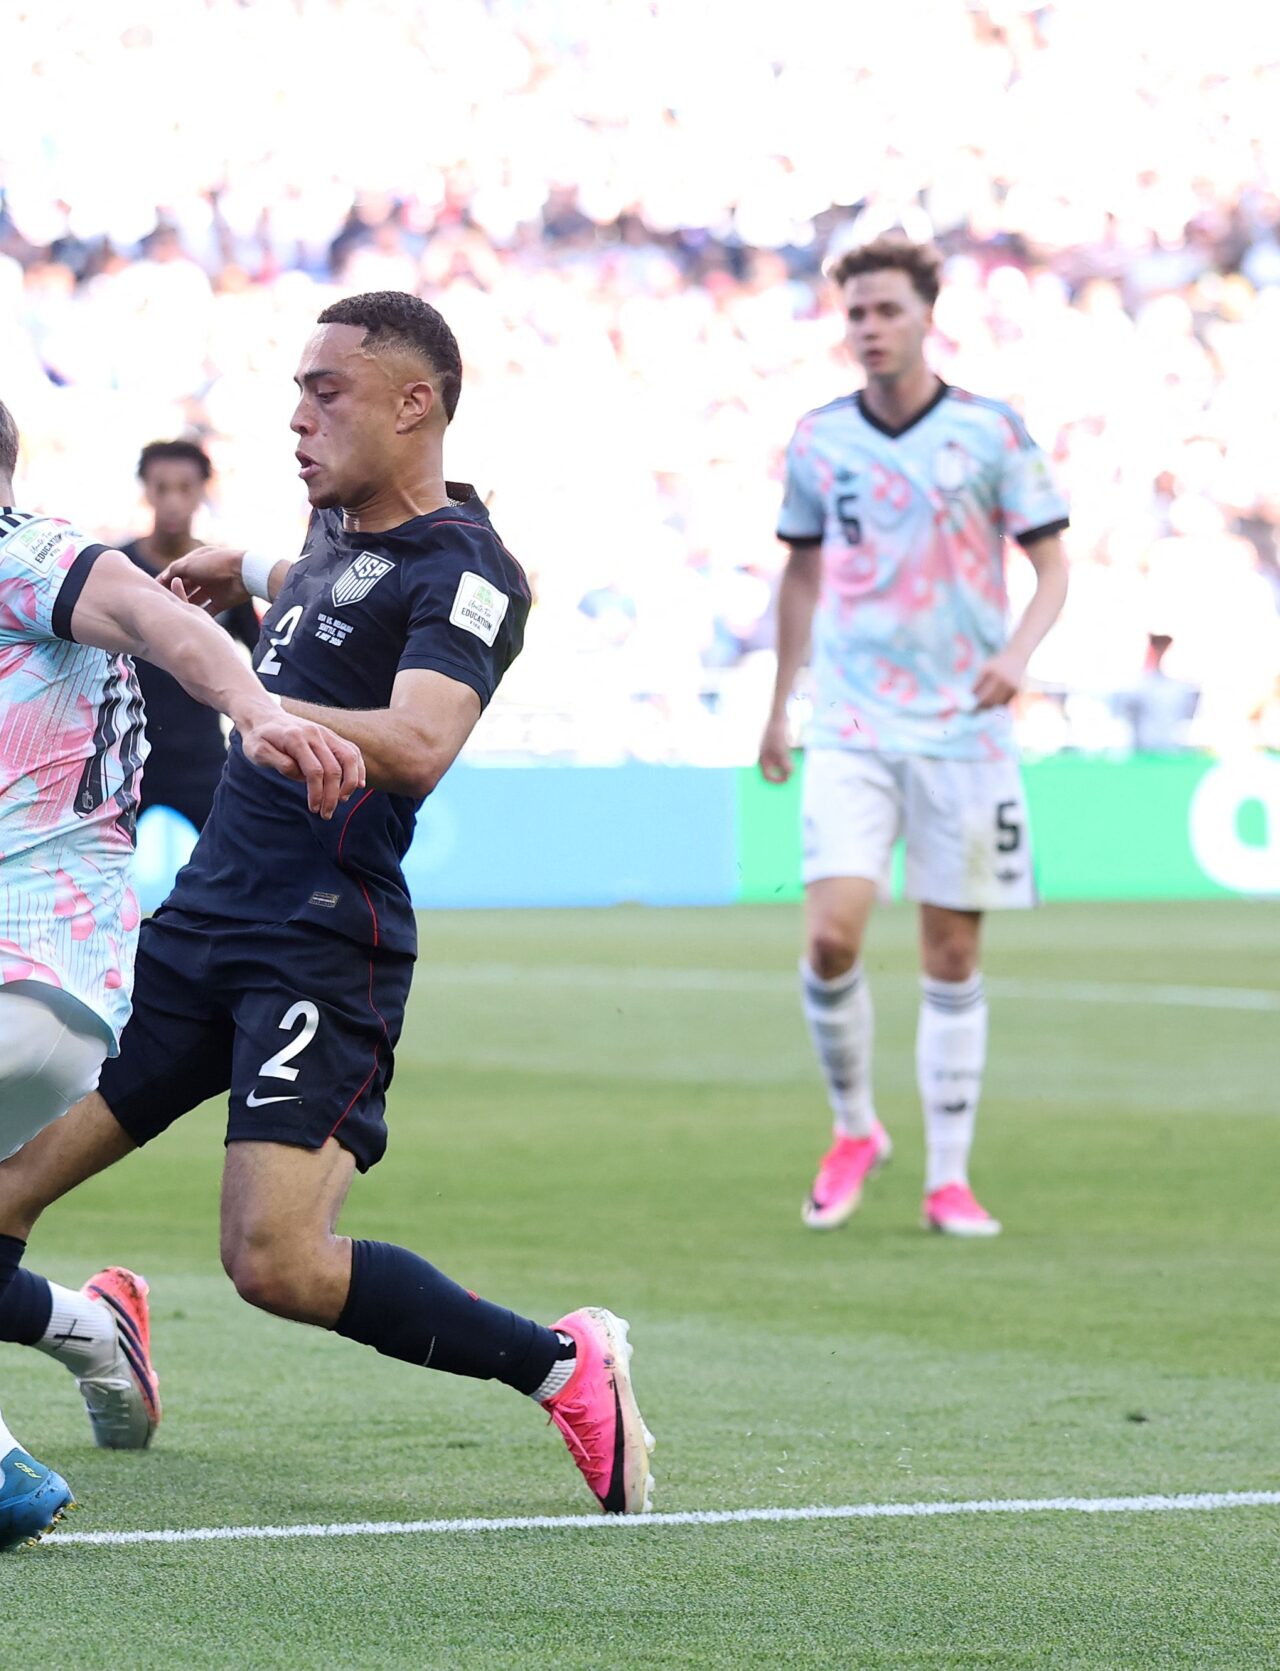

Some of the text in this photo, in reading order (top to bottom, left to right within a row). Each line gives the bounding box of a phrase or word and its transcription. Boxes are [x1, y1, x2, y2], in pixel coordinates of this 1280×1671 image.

[836, 494, 862, 545] 5
[34, 532, 63, 564] EDUCATION
[354, 555, 390, 578] USA
[256, 604, 304, 676] 2
[461, 607, 493, 631] EDUCATION
[995, 802, 1020, 852] 5
[258, 999, 320, 1082] 2
